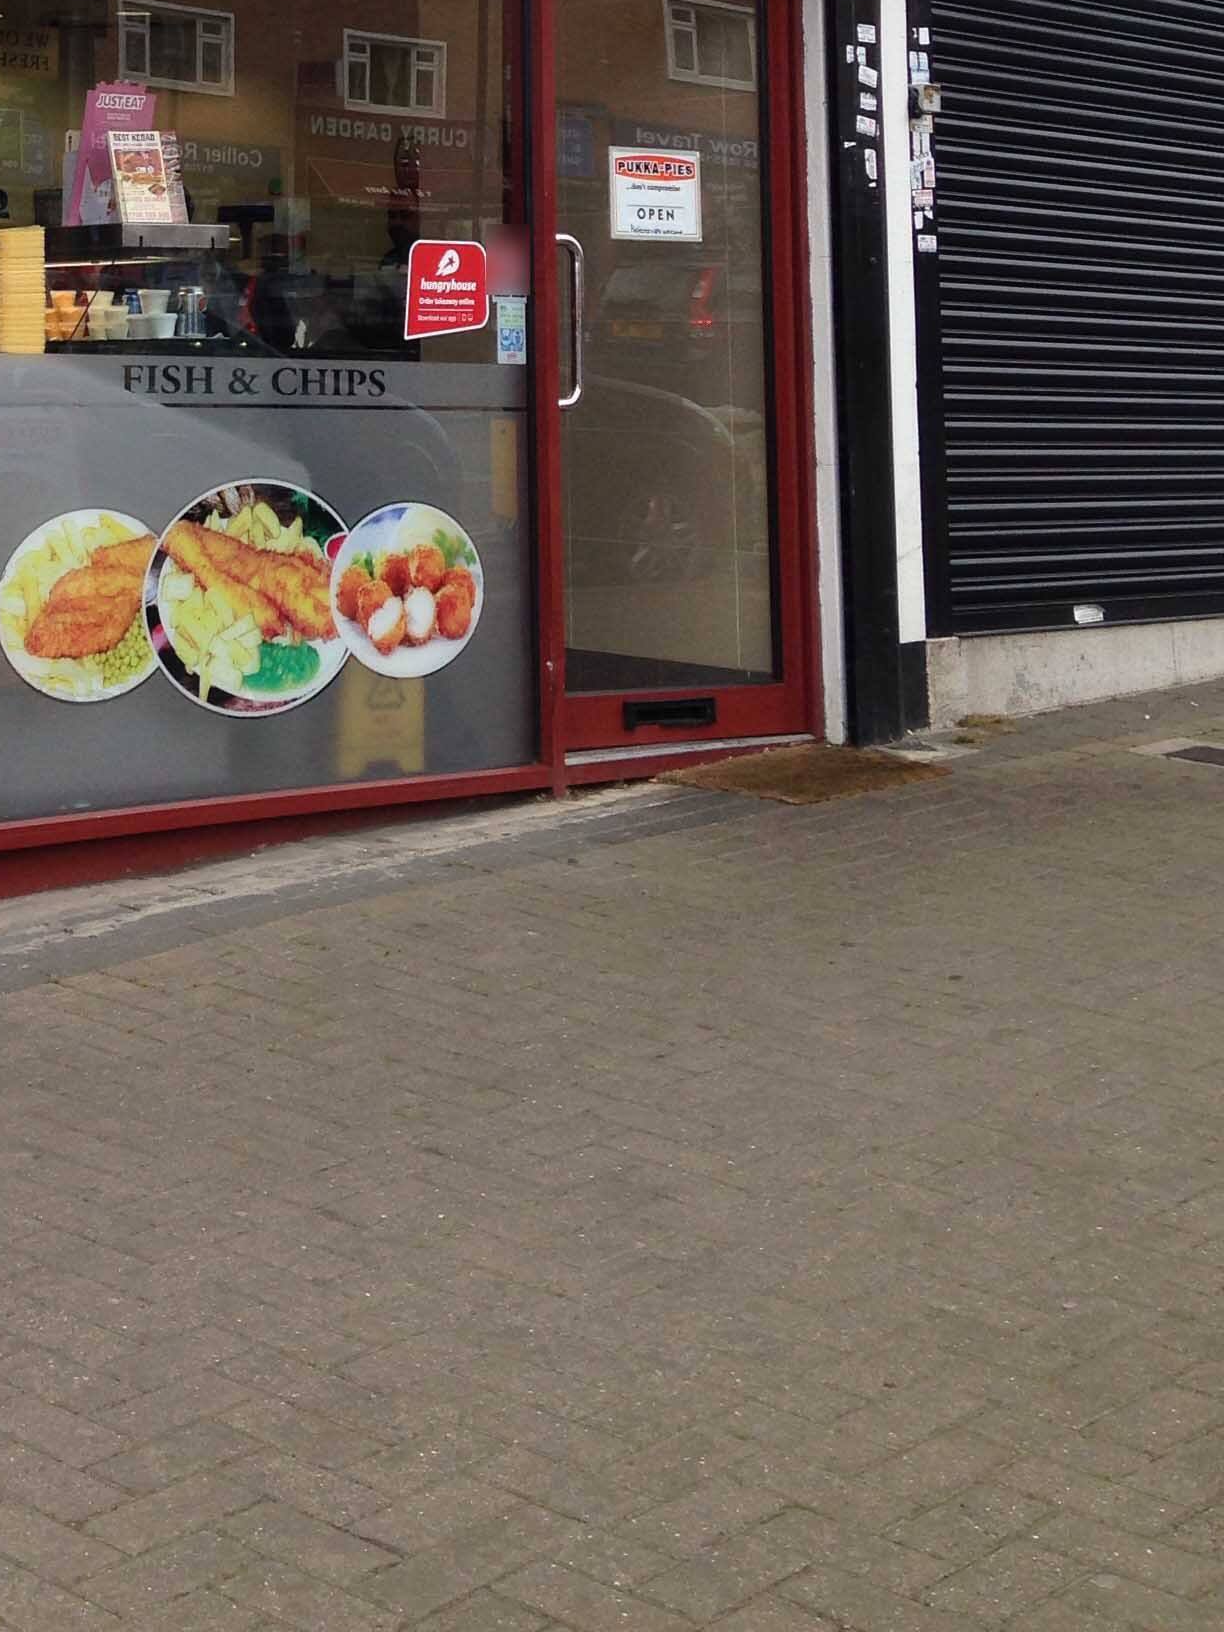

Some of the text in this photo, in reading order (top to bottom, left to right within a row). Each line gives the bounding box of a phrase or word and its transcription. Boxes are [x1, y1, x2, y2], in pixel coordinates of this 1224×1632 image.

[97, 94, 145, 109] JUST EAT
[618, 161, 693, 176] PUKKA-PIES
[637, 208, 675, 221] OPEN
[420, 278, 477, 293] hungryhouse
[121, 364, 387, 397] FISH & CHIPS
